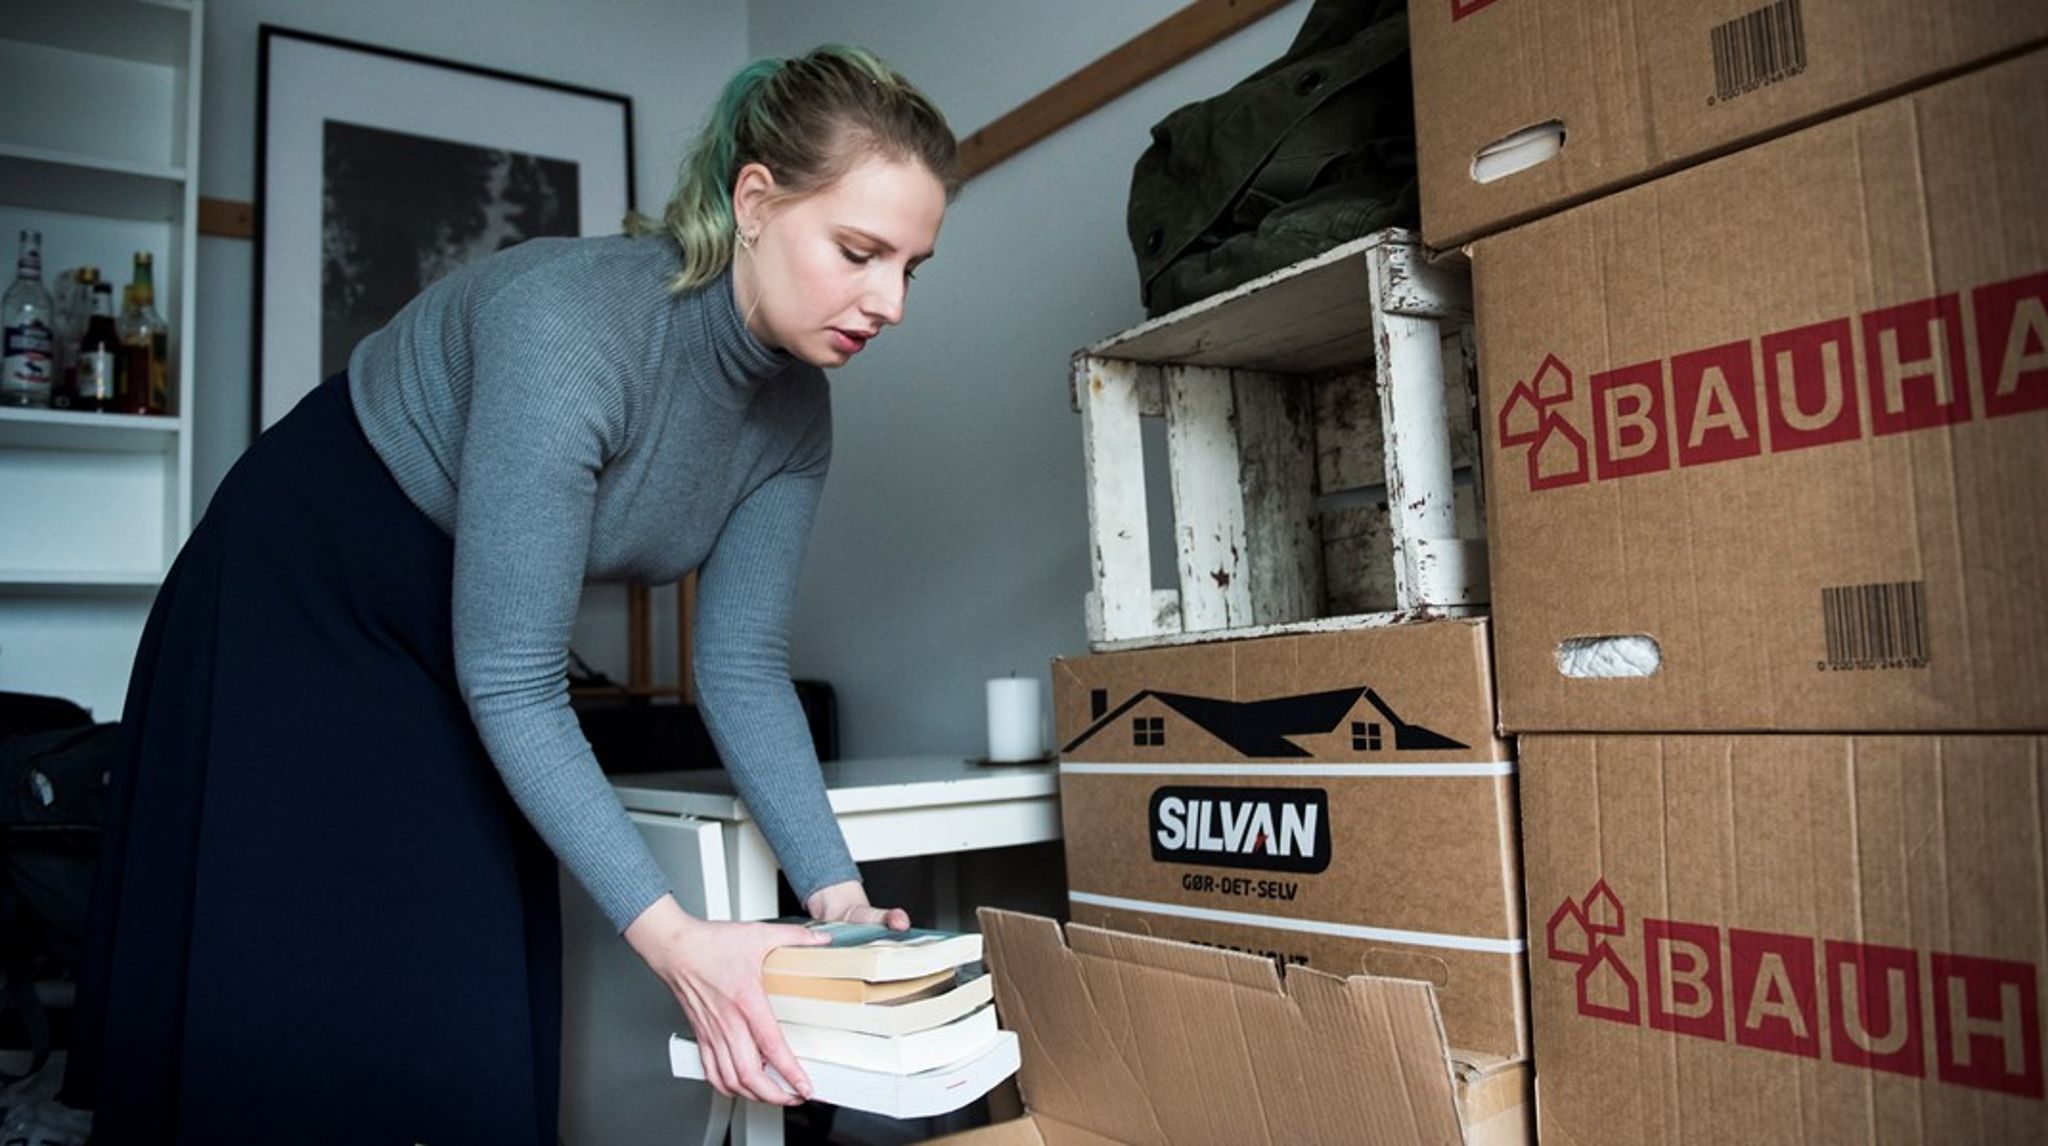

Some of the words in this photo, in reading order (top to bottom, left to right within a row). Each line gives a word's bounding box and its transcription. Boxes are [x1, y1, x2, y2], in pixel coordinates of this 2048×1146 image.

[1603, 296, 2048, 463] BAUHA
[1156, 796, 1318, 858] SILVAN
[1182, 873, 1298, 901] GØR-DET-SELV
[1656, 937, 2026, 1076] BAUH
